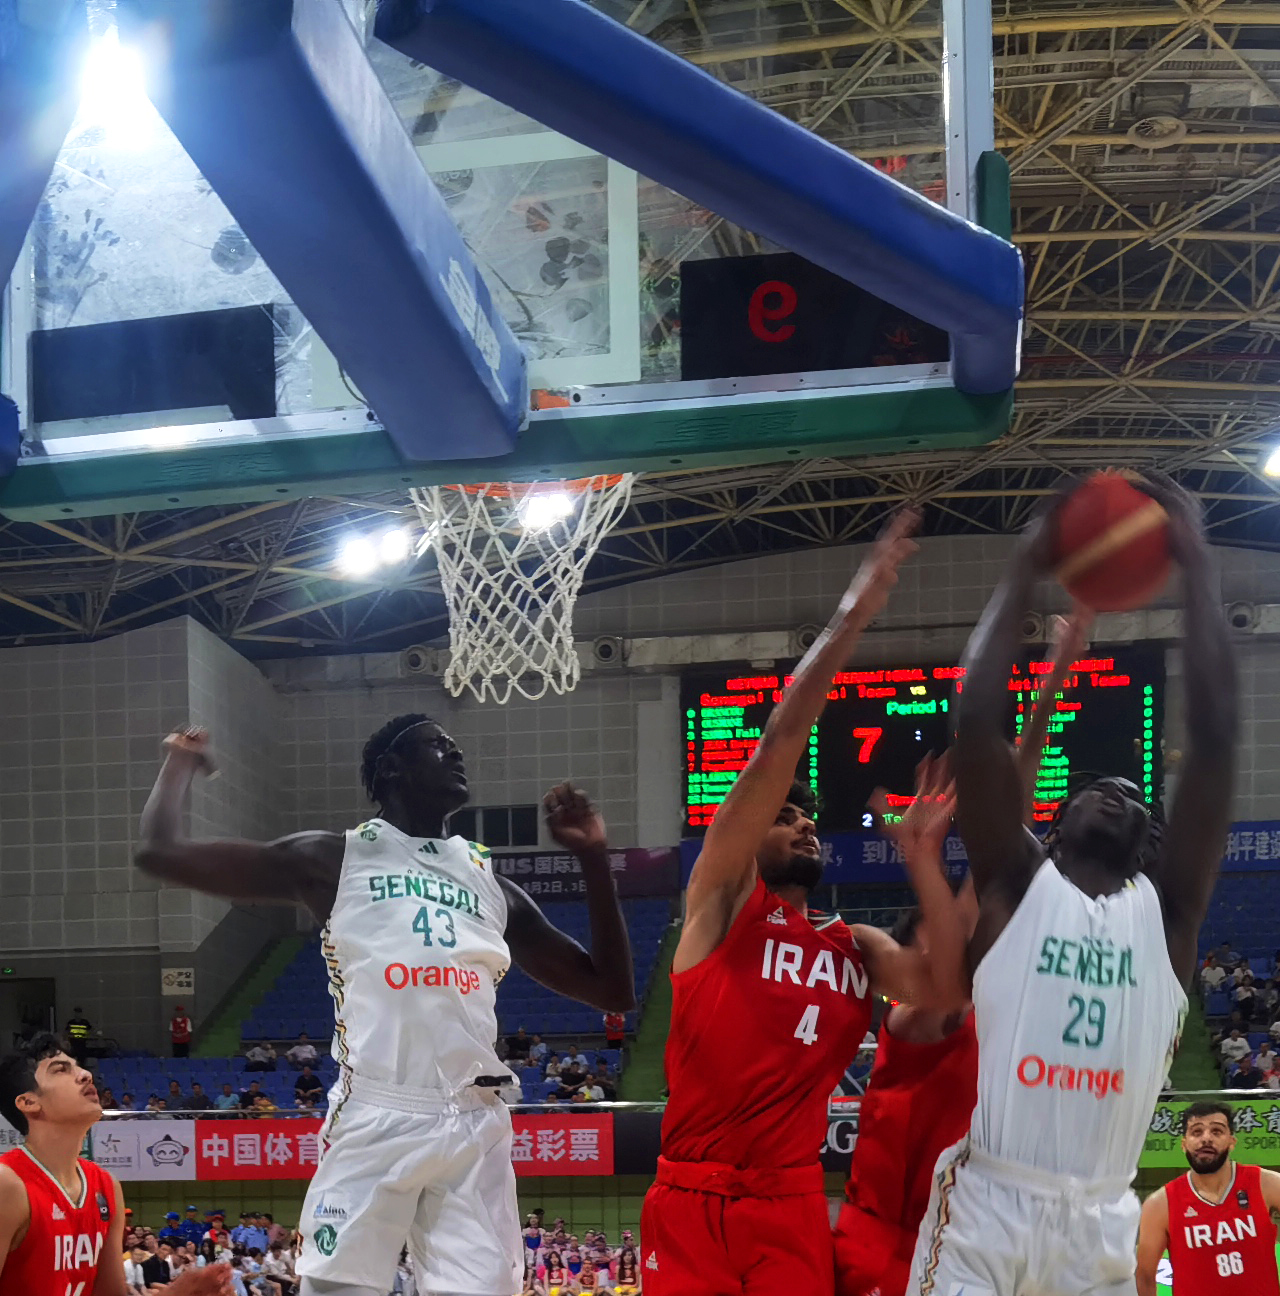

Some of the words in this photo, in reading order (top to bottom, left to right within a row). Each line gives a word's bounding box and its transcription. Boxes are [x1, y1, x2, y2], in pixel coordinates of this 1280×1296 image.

[886, 700, 936, 715] Period
[940, 699, 948, 713] 1
[853, 728, 883, 763] 7
[862, 813, 873, 828] 2
[369, 874, 485, 920] SENEGAL
[412, 906, 457, 948] 43
[384, 962, 480, 995] Orange
[761, 938, 869, 1000] IRAN
[793, 1004, 820, 1046] 4
[1062, 993, 1106, 1049] 29
[1017, 1055, 1126, 1100] Orange
[1184, 1215, 1257, 1249] IRAN
[1216, 1251, 1244, 1277] 86
